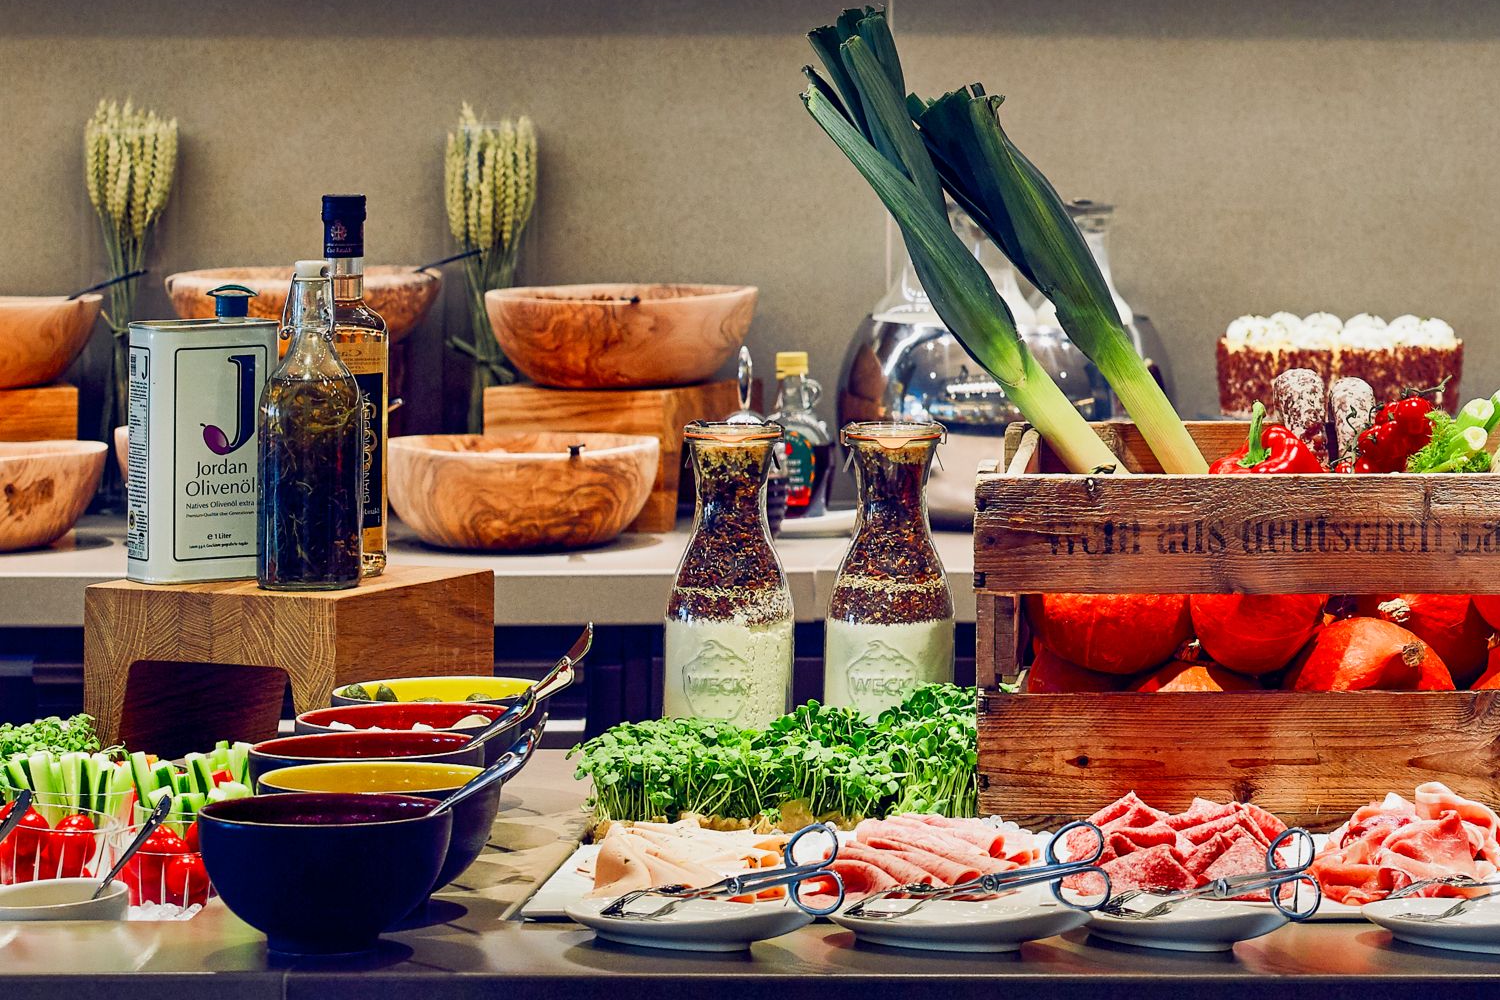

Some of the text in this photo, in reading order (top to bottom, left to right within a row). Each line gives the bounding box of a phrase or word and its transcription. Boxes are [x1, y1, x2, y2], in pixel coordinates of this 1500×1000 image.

[196, 458, 248, 478] Jordan
[185, 477, 255, 497] Olivenöl
[186, 502, 209, 510] Natives
[210, 500, 237, 508] Olivenöl
[690, 677, 748, 697] WECK
